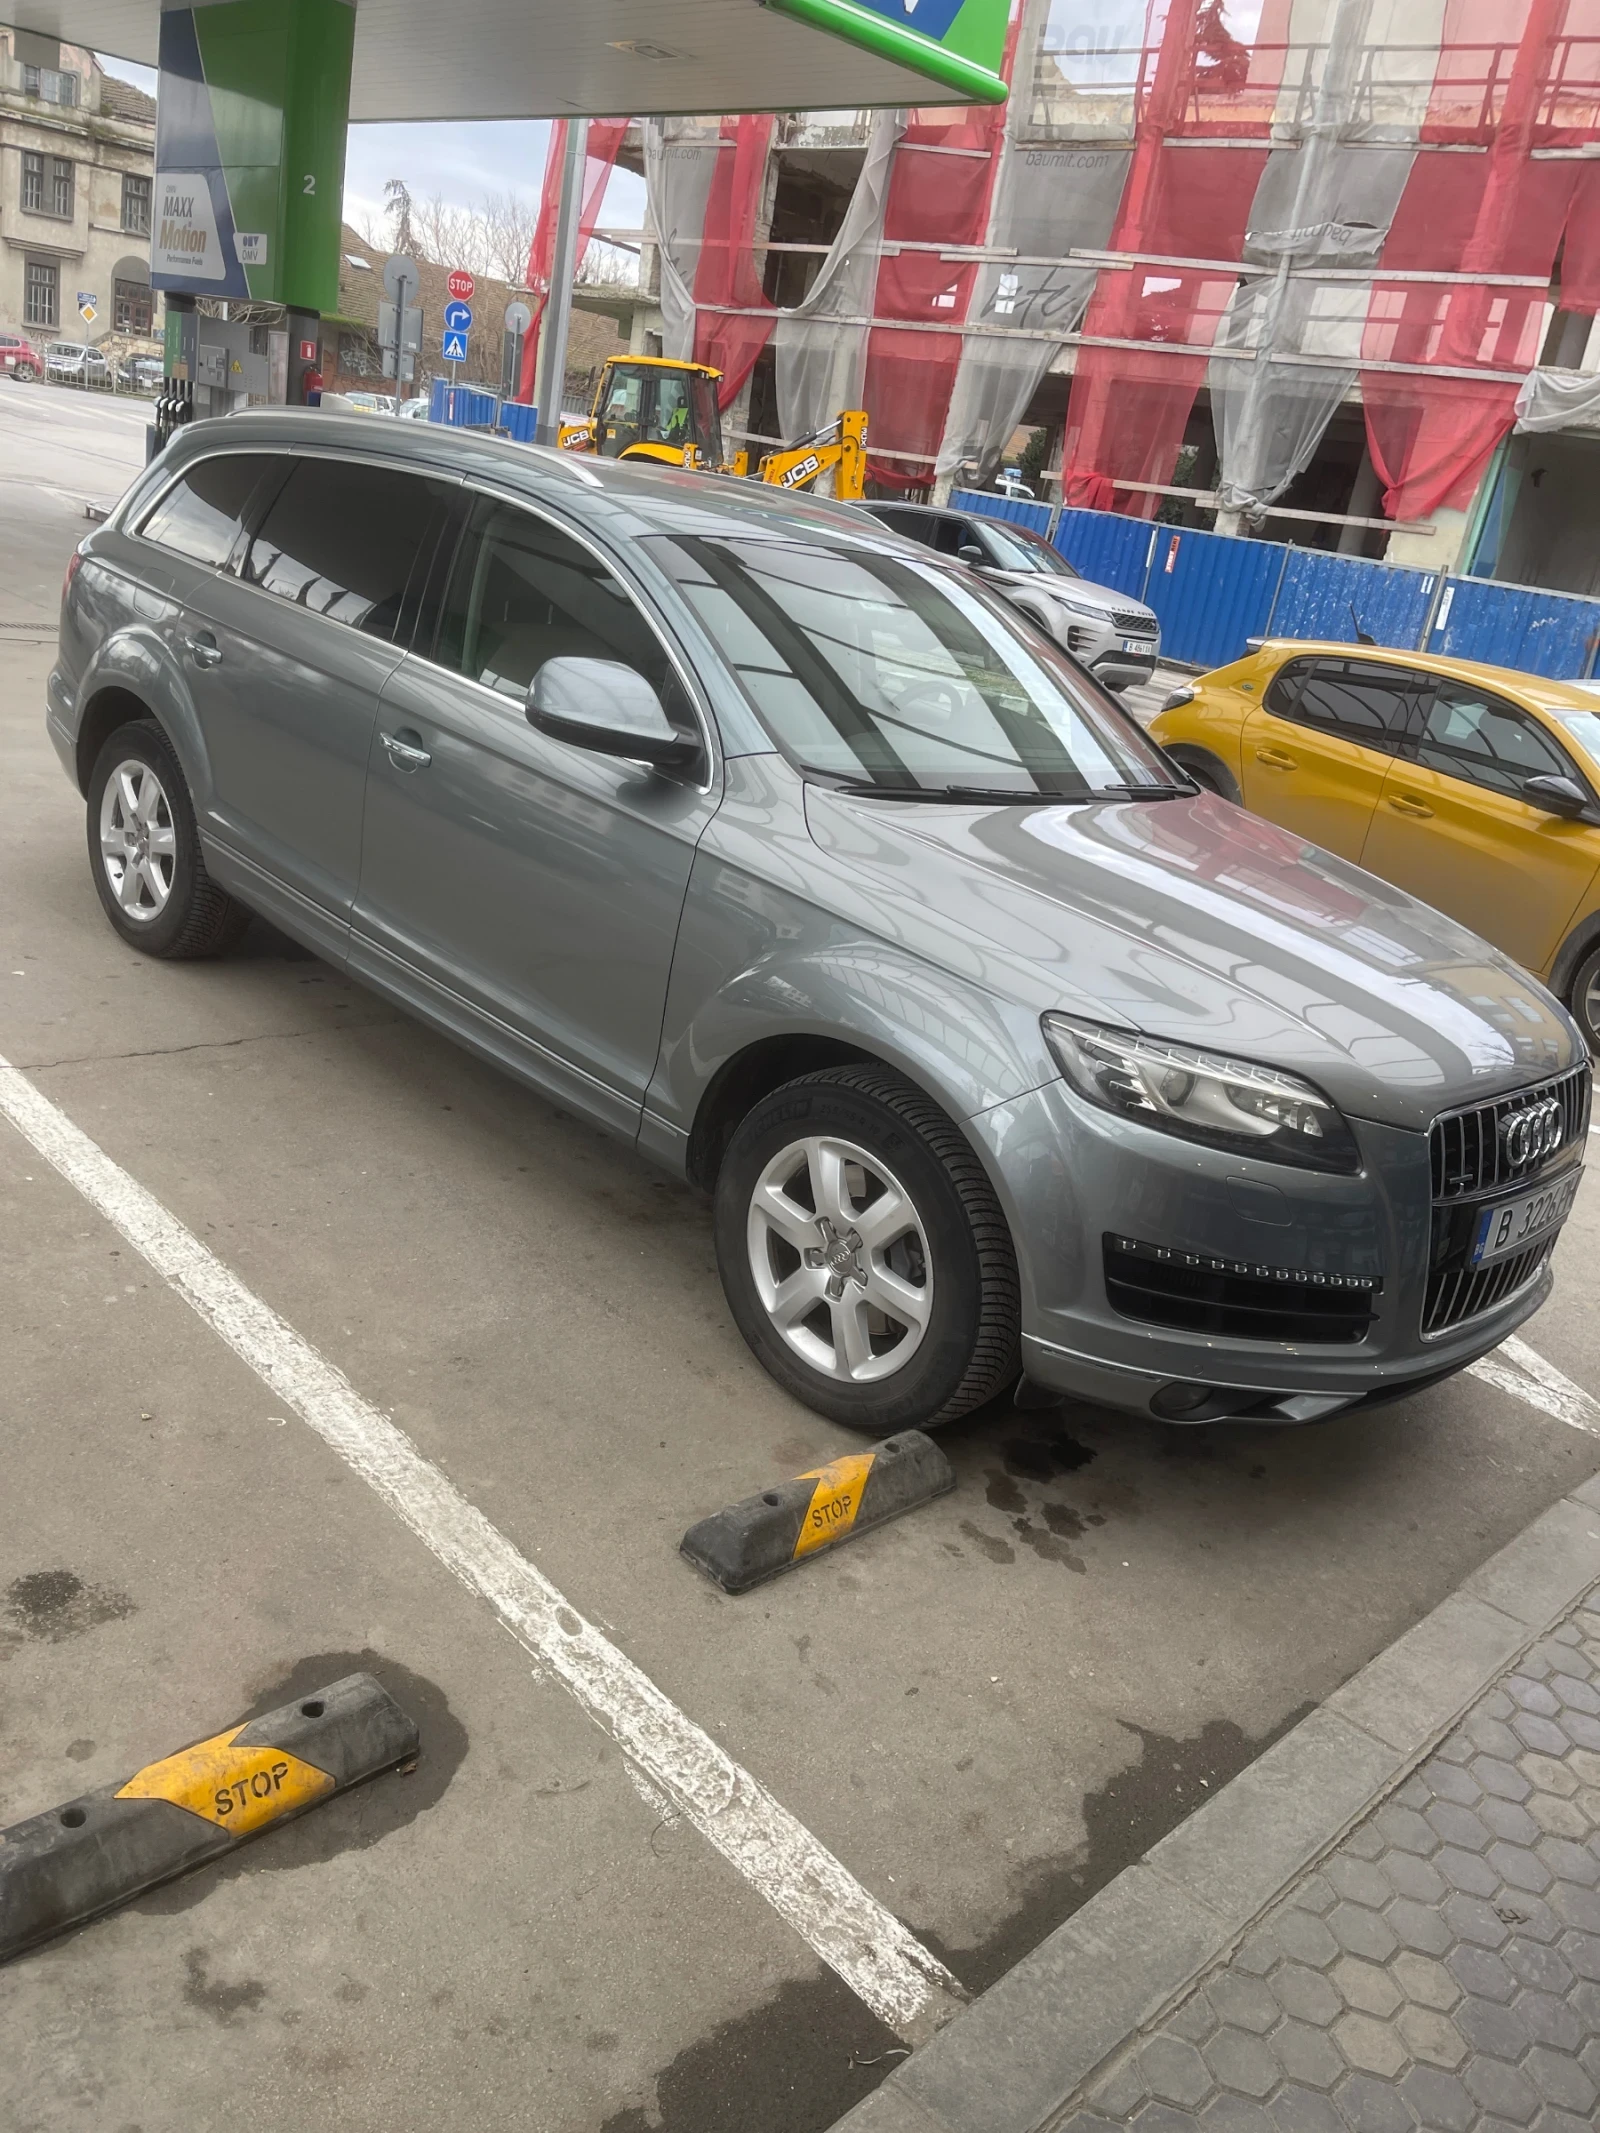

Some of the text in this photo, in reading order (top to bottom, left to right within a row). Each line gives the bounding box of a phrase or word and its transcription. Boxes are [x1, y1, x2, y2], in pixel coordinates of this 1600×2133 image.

[1025, 150, 1109, 169] baumit.com
[303, 174, 316, 195] 2
[163, 196, 194, 218] MAXX
[159, 219, 207, 253] Motion
[166, 254, 203, 266] Performance Fuels
[242, 250, 258, 261] OMV
[450, 278, 473, 292] STOP
[562, 429, 589, 447] JCB
[782, 455, 819, 488] JCB
[1494, 1209, 1513, 1249] B
[1474, 1241, 1485, 1256] BG
[812, 1495, 851, 1528] STOP
[215, 1762, 288, 1815] STOP
